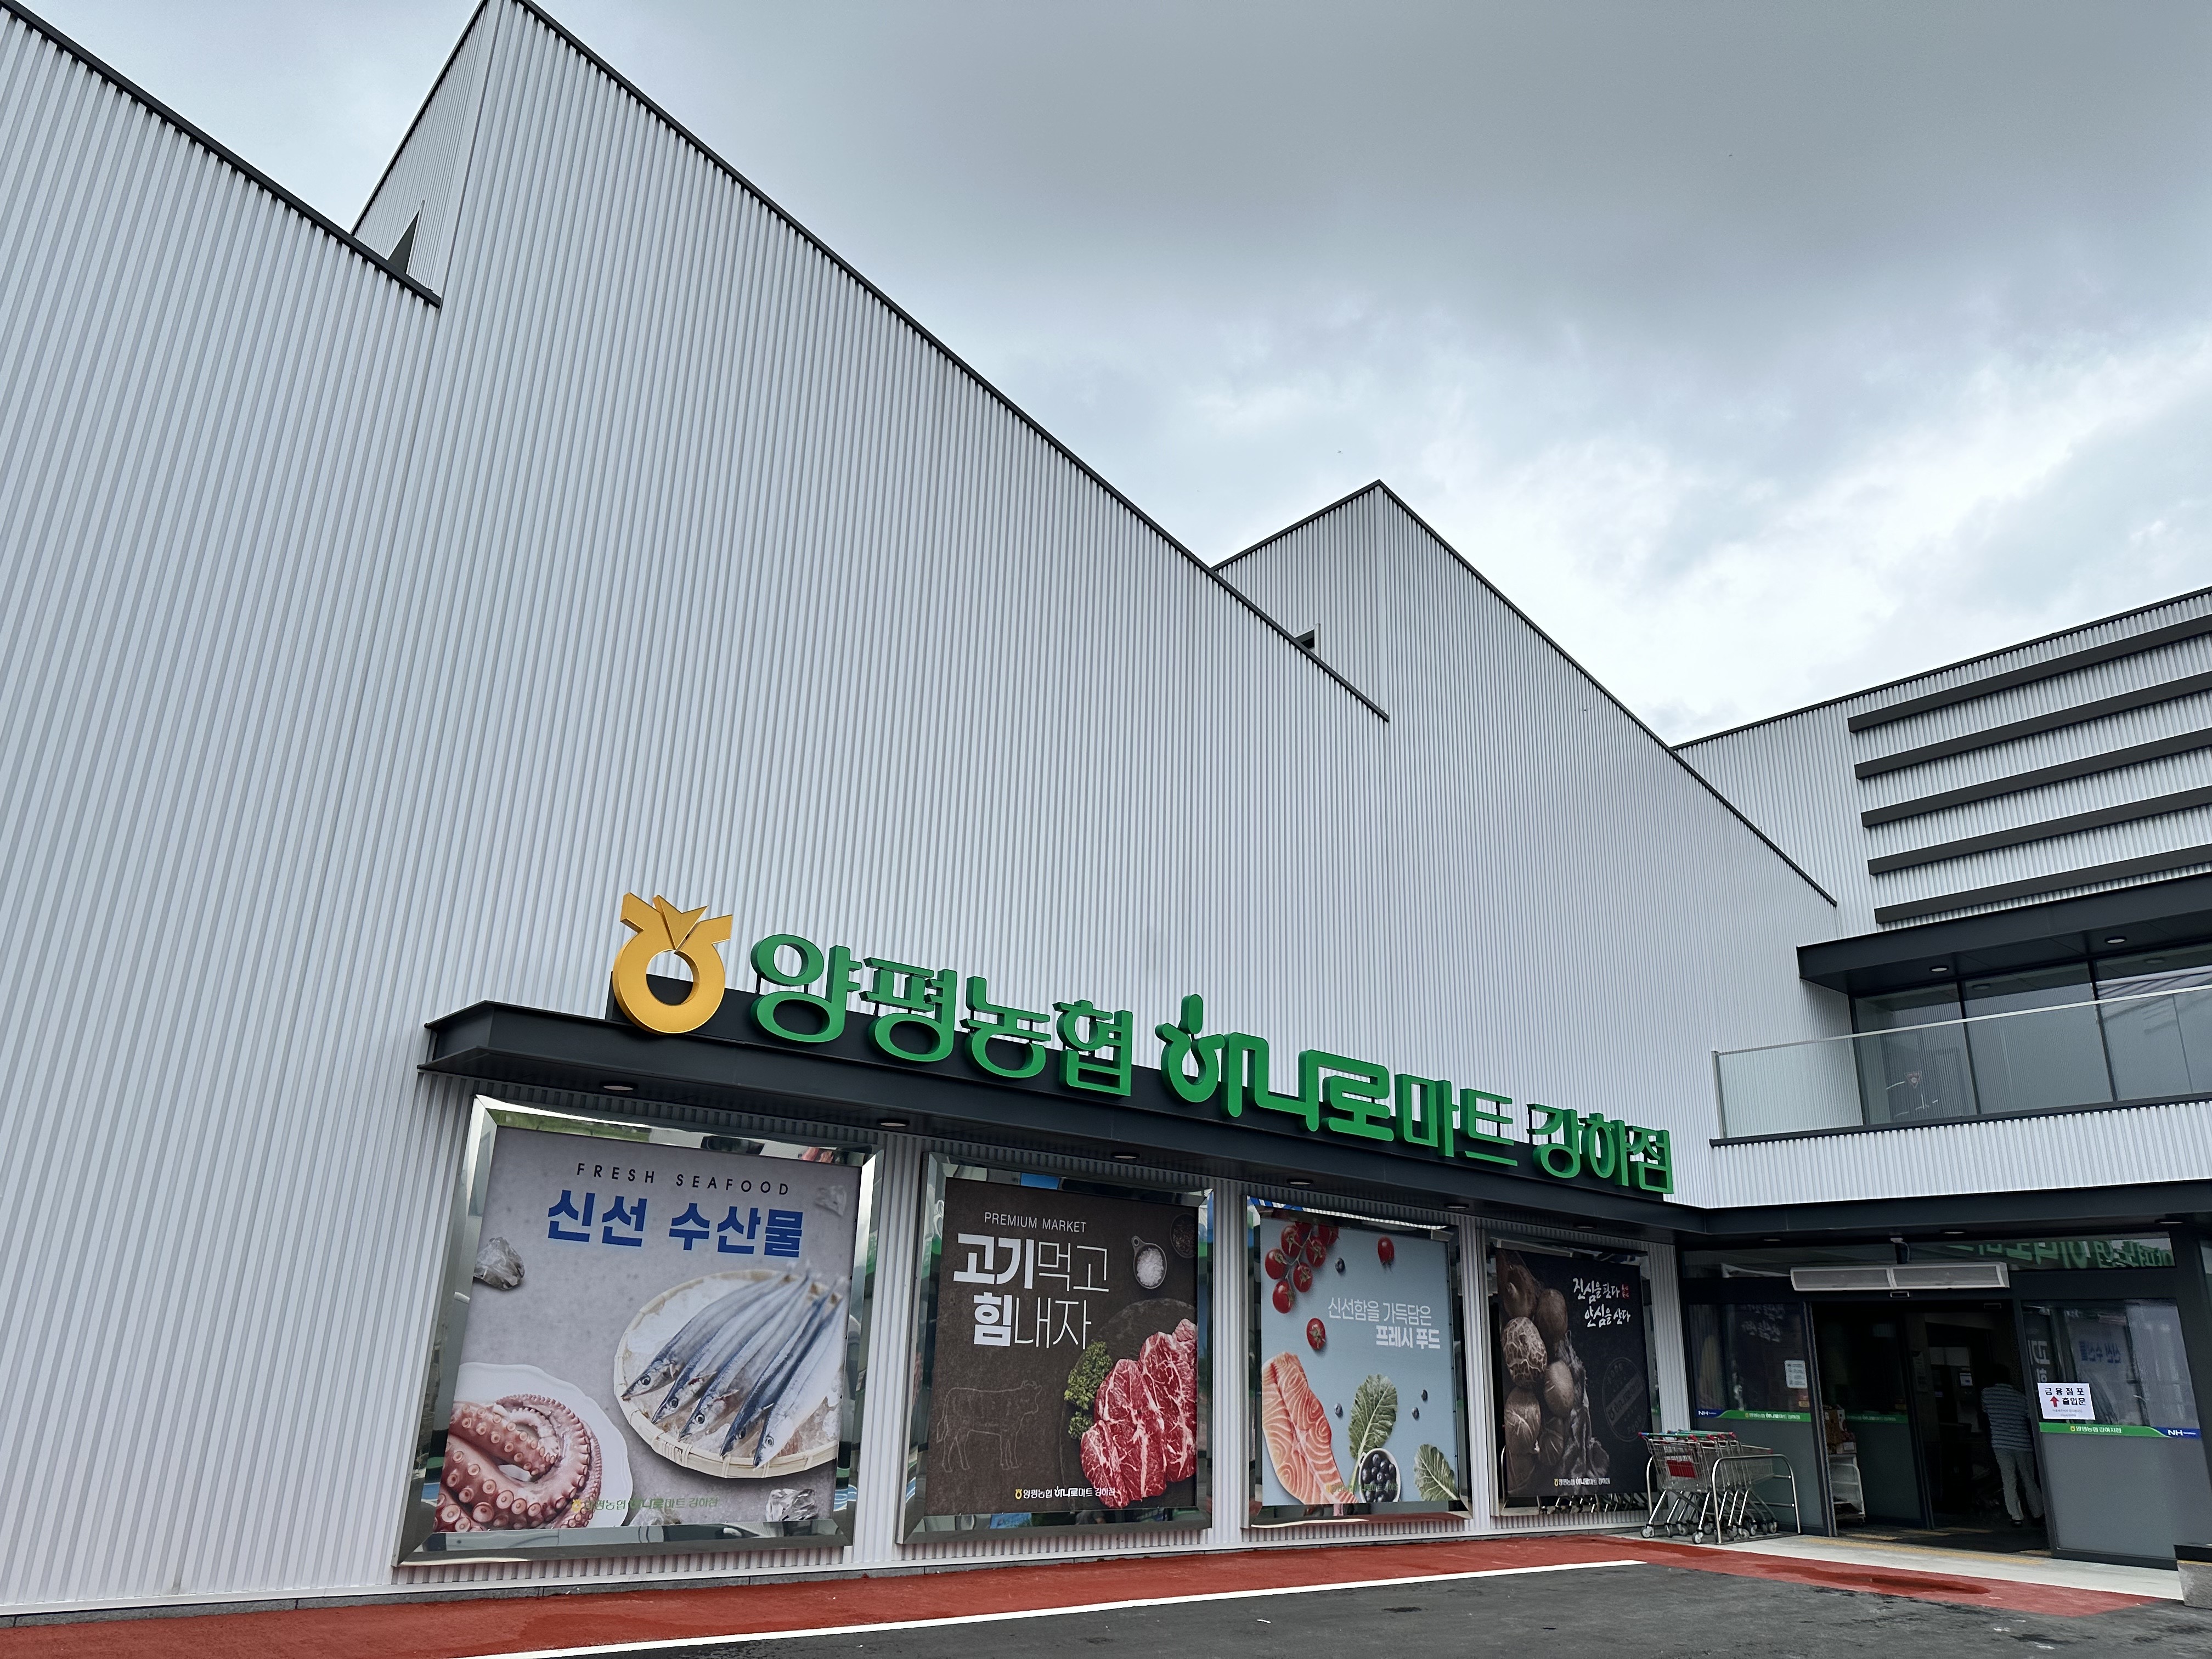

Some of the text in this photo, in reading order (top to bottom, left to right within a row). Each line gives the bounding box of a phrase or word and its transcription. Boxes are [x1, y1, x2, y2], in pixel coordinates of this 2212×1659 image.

[751, 934, 1674, 1194] 양평농협 하나로마트 강하점
[576, 1162, 789, 1196] FRESH SEAFOOD
[548, 1189, 804, 1258] 신선 수산물
[984, 1212, 1087, 1233] PREMIUM MARKET
[1572, 1278, 1602, 1304] 진심을
[1602, 1282, 1620, 1299] 판다
[973, 1291, 1092, 1350] 힘내자
[1328, 1297, 1432, 1326] 신선함을 가득담은
[1584, 1304, 1631, 1328] 안심을 산다
[1376, 1325, 1441, 1350] 프레시 푸드
[2062, 1397, 2086, 1406] 출입문
[689, 1497, 719, 1508] 강하점
[1023, 1488, 1052, 1499] 양평농협
[1054, 1485, 1093, 1498] 하나로마트
